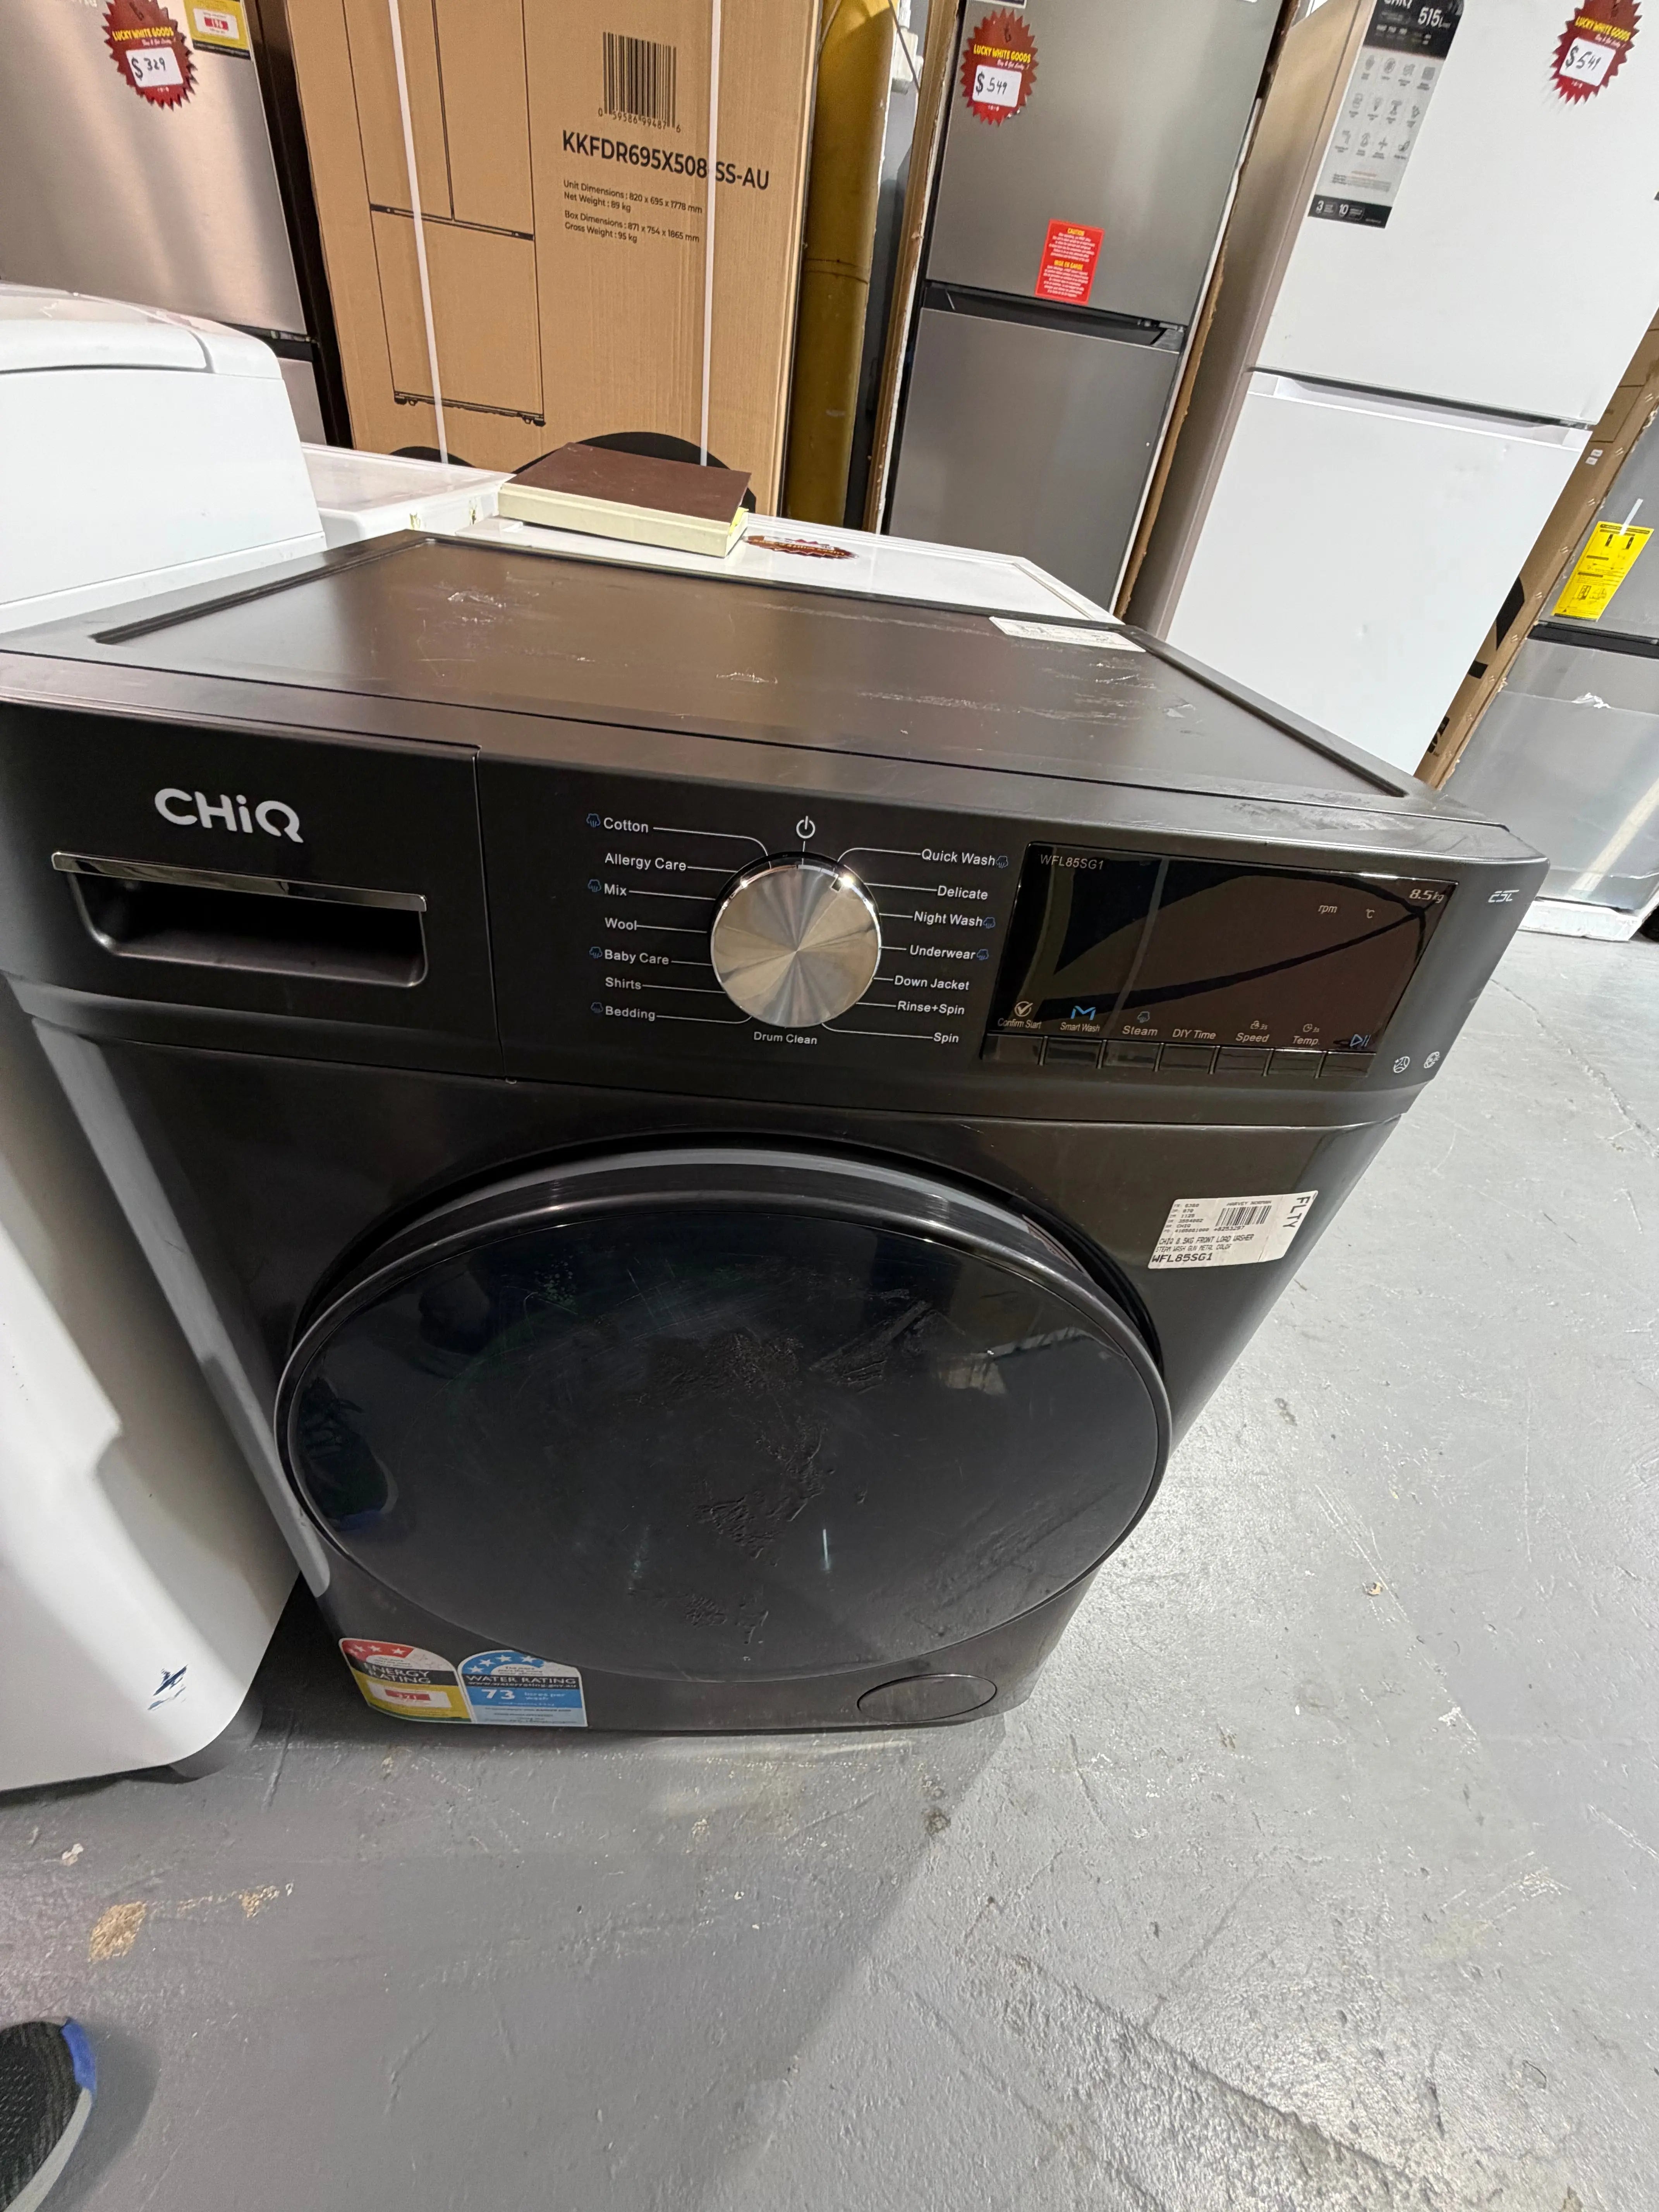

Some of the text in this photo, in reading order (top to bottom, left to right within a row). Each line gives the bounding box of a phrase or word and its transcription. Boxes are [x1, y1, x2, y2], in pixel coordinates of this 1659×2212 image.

[112, 26, 174, 41] LUCKY WHITE GOODS
[973, 44, 1031, 64] LUCKY WHITE GOODS
[564, 180, 579, 190] Unit
[581, 183, 624, 199] Dimensions
[629, 193, 642, 202] 820
[650, 196, 663, 206] 695
[671, 200, 686, 210] 1778
[688, 205, 702, 213] mm
[564, 191, 577, 201] Net
[579, 194, 606, 206] Weight
[622, 202, 631, 213] kg
[565, 210, 579, 220] Box
[580, 213, 623, 228] Dimensions
[628, 222, 639, 231] 871
[647, 225, 660, 235] 754
[668, 229, 683, 240] 1865
[685, 234, 699, 243] mm
[587, 225, 613, 238] Weight
[618, 231, 626, 240] 95
[628, 233, 637, 244] kg
[604, 818, 648, 833] Cotton
[605, 854, 686, 871] Allergy Care
[922, 849, 995, 866] Quick Wash
[1041, 854, 1104, 870] WFL85SG1
[605, 884, 627, 896] Mix
[937, 886, 988, 900] Delicate
[1318, 905, 1338, 914] rpm
[605, 918, 637, 930] Wool
[914, 912, 983, 927] Night Wash
[605, 950, 669, 965] Baby Care
[910, 945, 975, 960] Underwear
[605, 977, 641, 990] Shirts
[895, 976, 970, 991] Down Jacket
[606, 1006, 655, 1021] Bedding
[898, 1001, 965, 1015] Rinse+Spin
[998, 1018, 1042, 1029] Confirm Start
[1060, 1022, 1100, 1032] Smart Wash
[1122, 1025, 1158, 1036] Steam
[754, 1032, 817, 1044] Drum Clean
[934, 1033, 959, 1044] Spin
[1172, 1029, 1216, 1039] DIY Time
[1236, 1032, 1270, 1042] Speed
[1283, 1196, 1311, 1228] FLTY
[1152, 1253, 1213, 1263] WFL85SG1
[481, 1689, 515, 1699] 73
